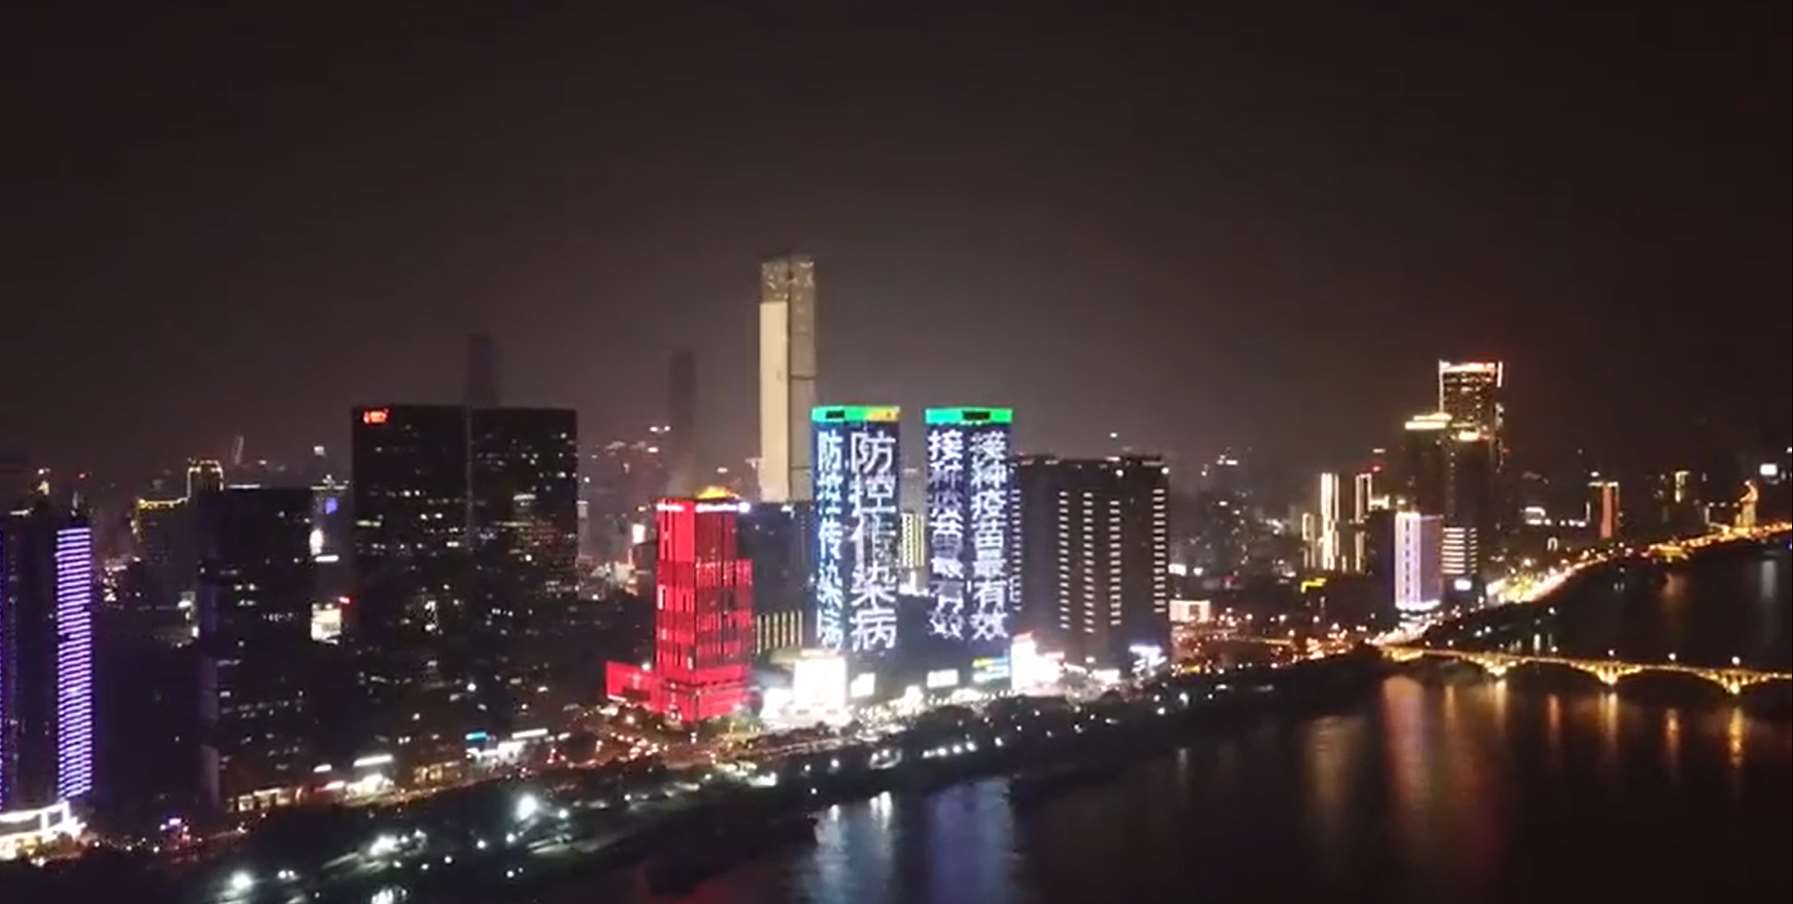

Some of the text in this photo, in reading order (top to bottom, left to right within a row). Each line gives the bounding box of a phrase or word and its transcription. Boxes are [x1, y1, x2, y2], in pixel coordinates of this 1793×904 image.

[849, 430, 897, 652] 防控传染病
[969, 431, 1008, 640] 接种疫苗最有效
